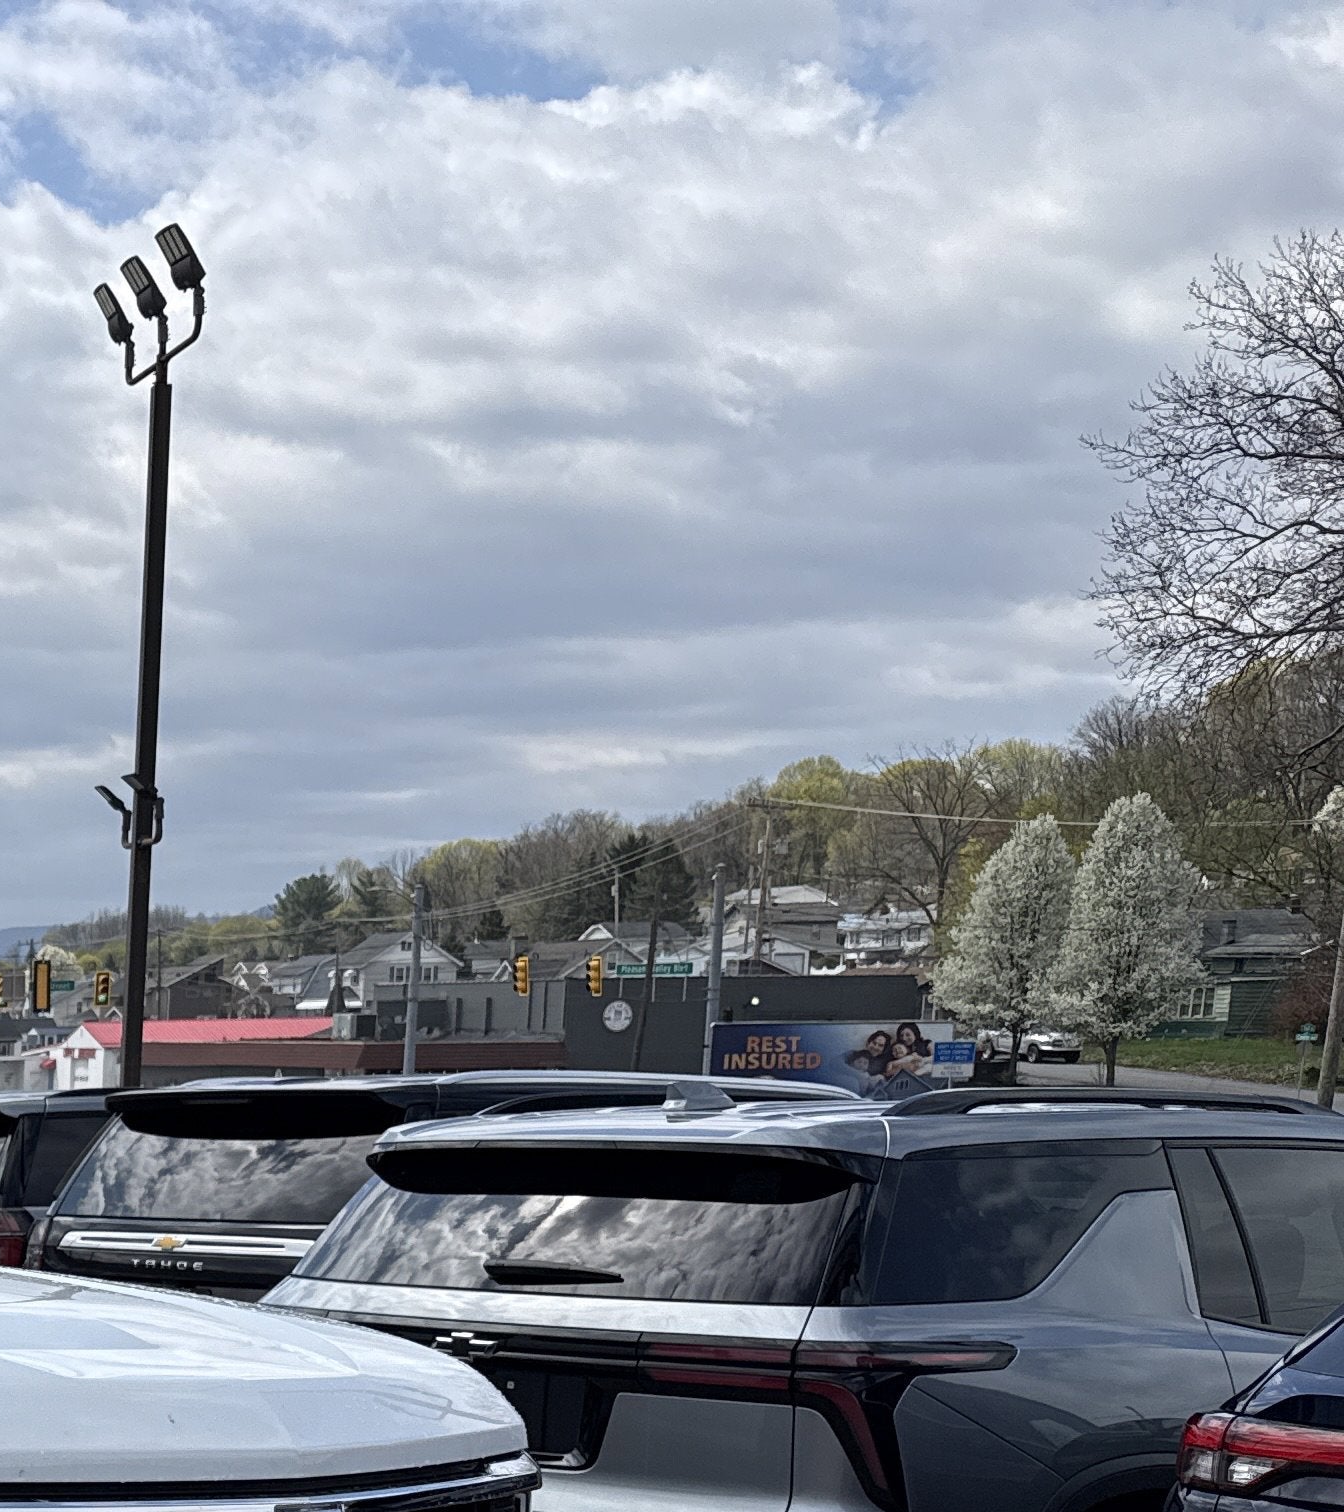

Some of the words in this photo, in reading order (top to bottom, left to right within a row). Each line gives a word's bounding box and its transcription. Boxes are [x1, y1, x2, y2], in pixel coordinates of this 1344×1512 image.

[746, 1036, 801, 1053] REST
[723, 1053, 822, 1070] INSURED
[131, 1258, 204, 1272] TAHOE
